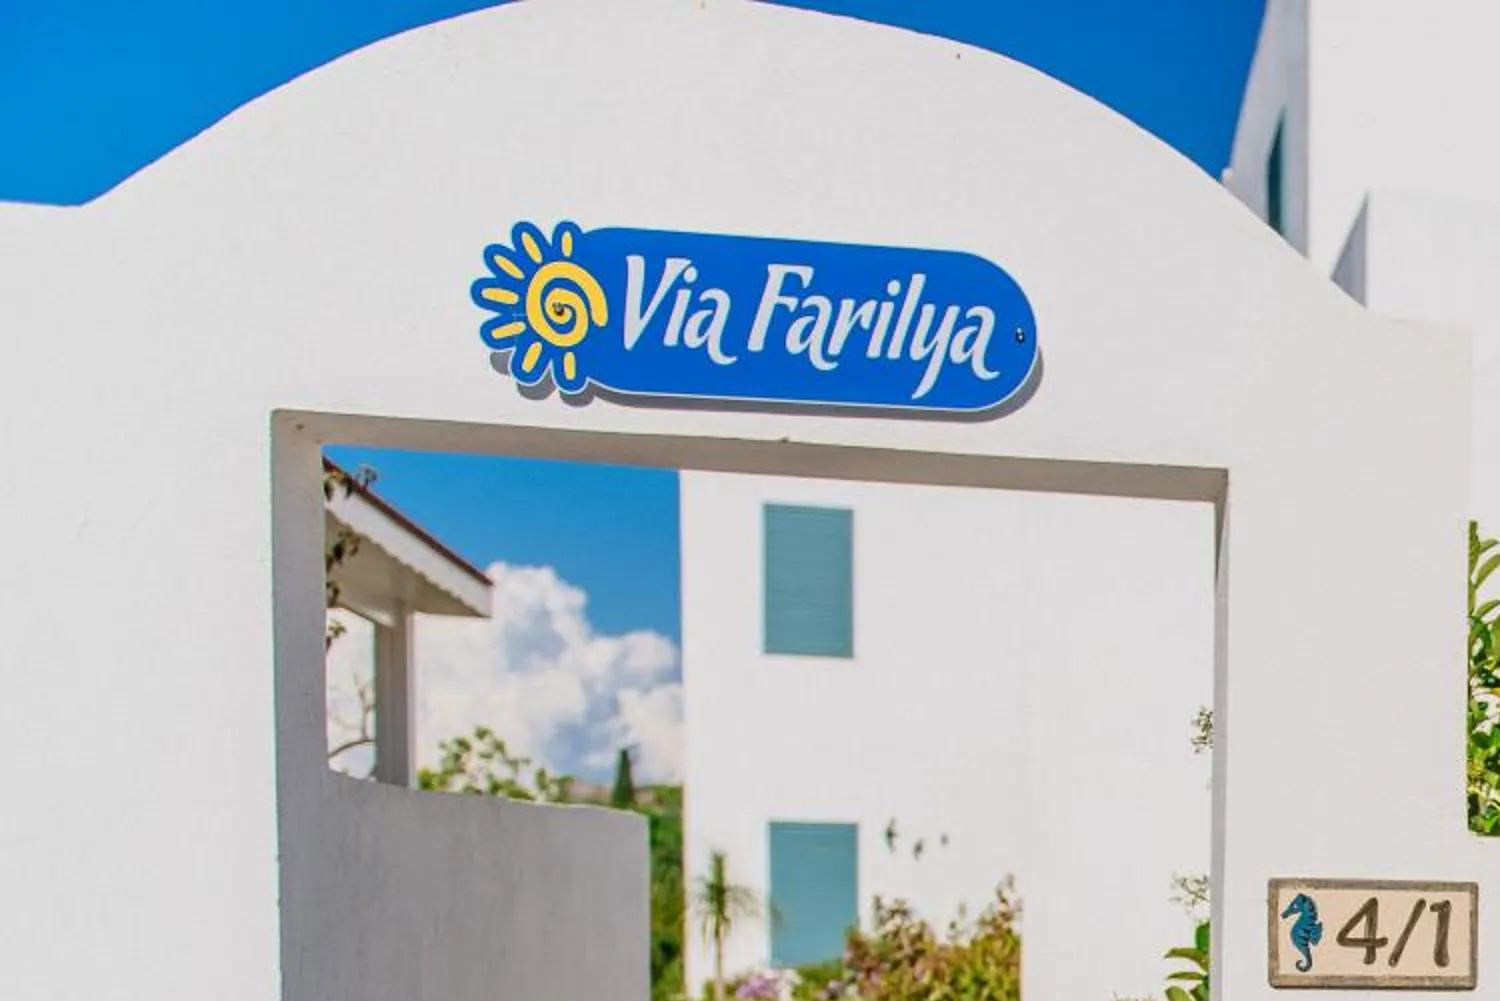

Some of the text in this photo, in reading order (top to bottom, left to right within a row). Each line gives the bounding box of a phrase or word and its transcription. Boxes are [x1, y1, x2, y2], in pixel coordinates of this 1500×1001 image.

[623, 254, 999, 399] Via Farilya
[1336, 897, 1451, 967] 4/1
